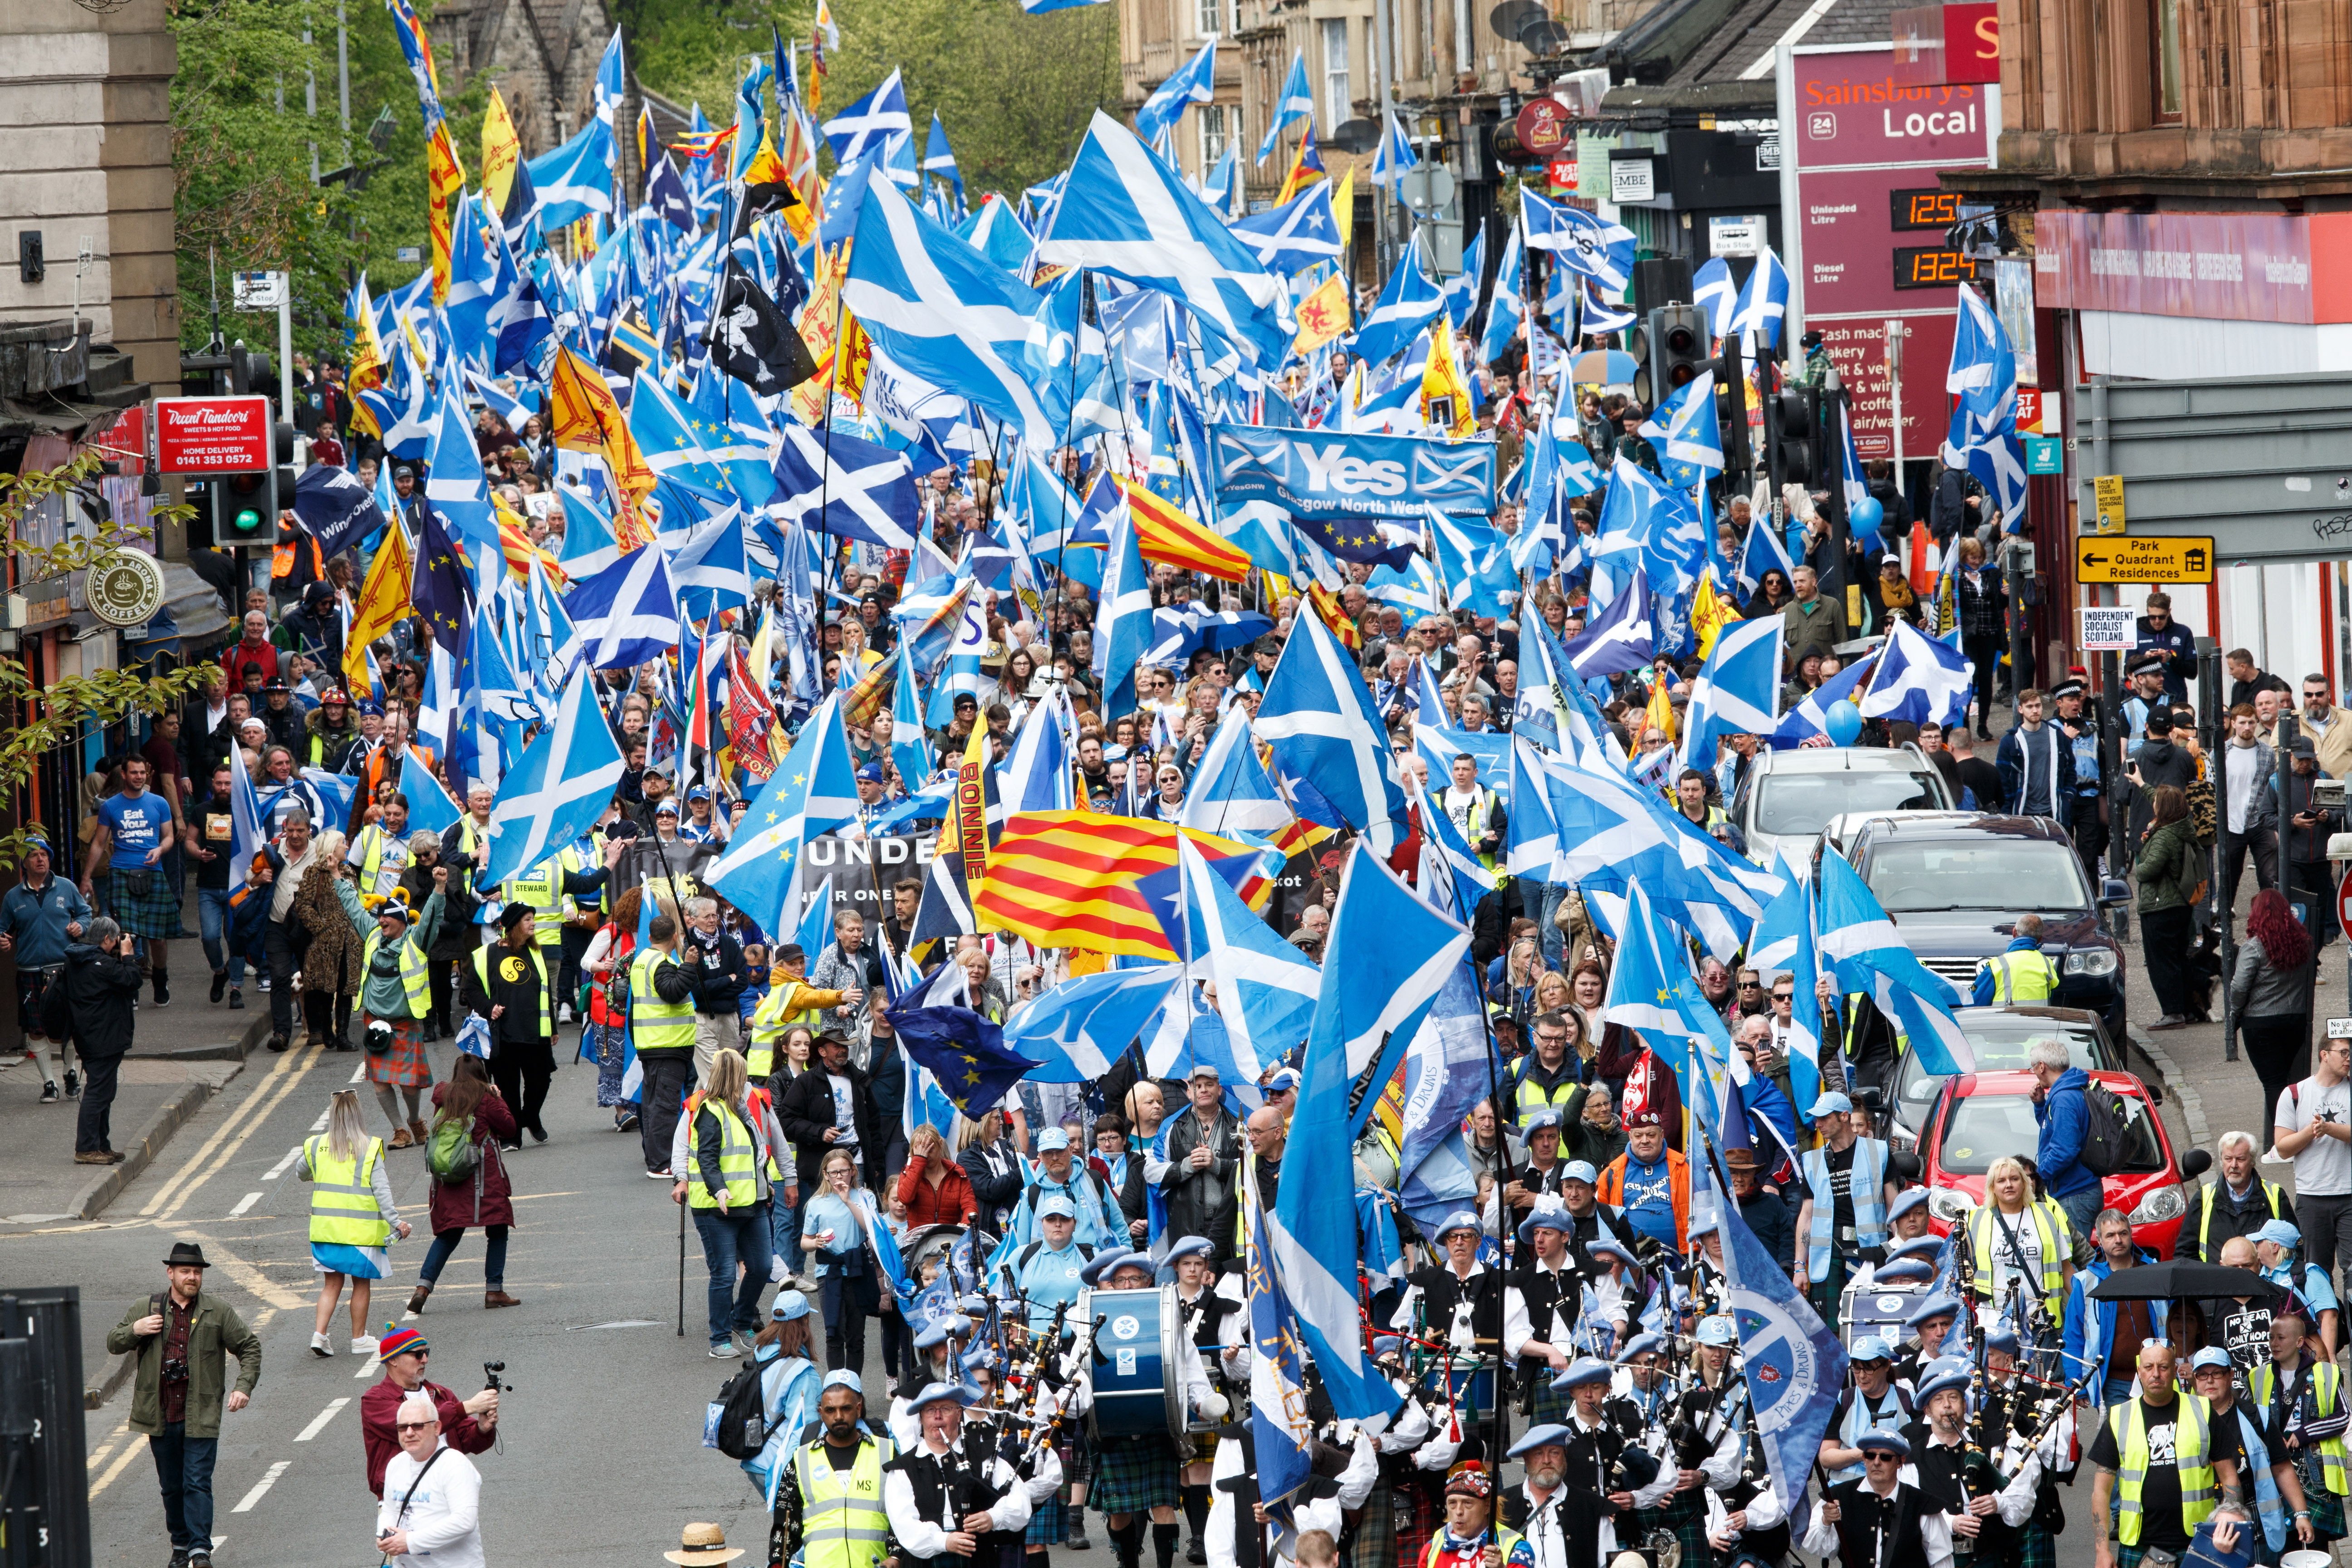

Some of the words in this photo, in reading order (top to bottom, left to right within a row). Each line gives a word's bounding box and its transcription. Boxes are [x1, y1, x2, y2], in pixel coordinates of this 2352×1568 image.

[1806, 75, 1974, 105] Sainsburys
[1813, 118, 1831, 129] 24
[1885, 105, 1976, 138] Local
[1766, 146, 1779, 156] MB
[1619, 175, 1646, 187] MBE
[1811, 204, 1856, 214] Unleaded
[1811, 215, 1836, 225] Litre
[1815, 264, 1844, 274] Diesel
[1815, 274, 1839, 284] Litre
[256, 294, 274, 303] Stop
[1819, 328, 1851, 341] Cash
[1827, 347, 1865, 361] akery
[1853, 363, 1865, 376] &
[1856, 381, 1868, 393] &
[2017, 393, 2034, 406] ST
[202, 406, 249, 425] Tandoori
[2016, 407, 2035, 419] AT
[1853, 415, 1916, 432] air/waer
[207, 446, 245, 455] DELIVERY
[176, 456, 202, 466] 0141
[204, 455, 224, 465] 353
[225, 454, 252, 464] 0572
[1293, 441, 1407, 496] Yes
[1277, 485, 1336, 514] Glasgow
[1341, 498, 1386, 514] North
[2131, 540, 2160, 552] Park
[2115, 554, 2175, 567] Quadrant
[129, 559, 154, 591] AROMA
[2110, 567, 2180, 578] Residences
[102, 601, 150, 619] COFFEE
[2085, 612, 2133, 621] INDEPENDENT
[961, 600, 982, 645] S
[2085, 622, 2123, 631] SOCIALIST
[2085, 632, 2123, 641] SCOTLAND
[124, 809, 144, 819] Eat
[120, 819, 148, 830] Your
[959, 762, 988, 881] BONNIE
[117, 827, 153, 838] Cereal
[523, 871, 544, 880] es2
[854, 888, 894, 902] ONE
[466, 1037, 476, 1054] INDY
[1417, 1065, 1439, 1107] DRUMS
[1626, 1175, 1671, 1192] SCOTTISH
[1641, 1186, 1660, 1200] NOT
[1634, 1192, 1671, 1209] BRITISH
[2230, 1317, 2241, 1327] NO
[2246, 1311, 2268, 1323] EAR
[2229, 1333, 2249, 1346] ONLY
[1775, 1387, 1802, 1420] PIPES
[1795, 1341, 1810, 1380] DRUMS
[34, 1418, 42, 1438] 2
[857, 1480, 872, 1491] MS
[39, 1528, 49, 1547] 3
